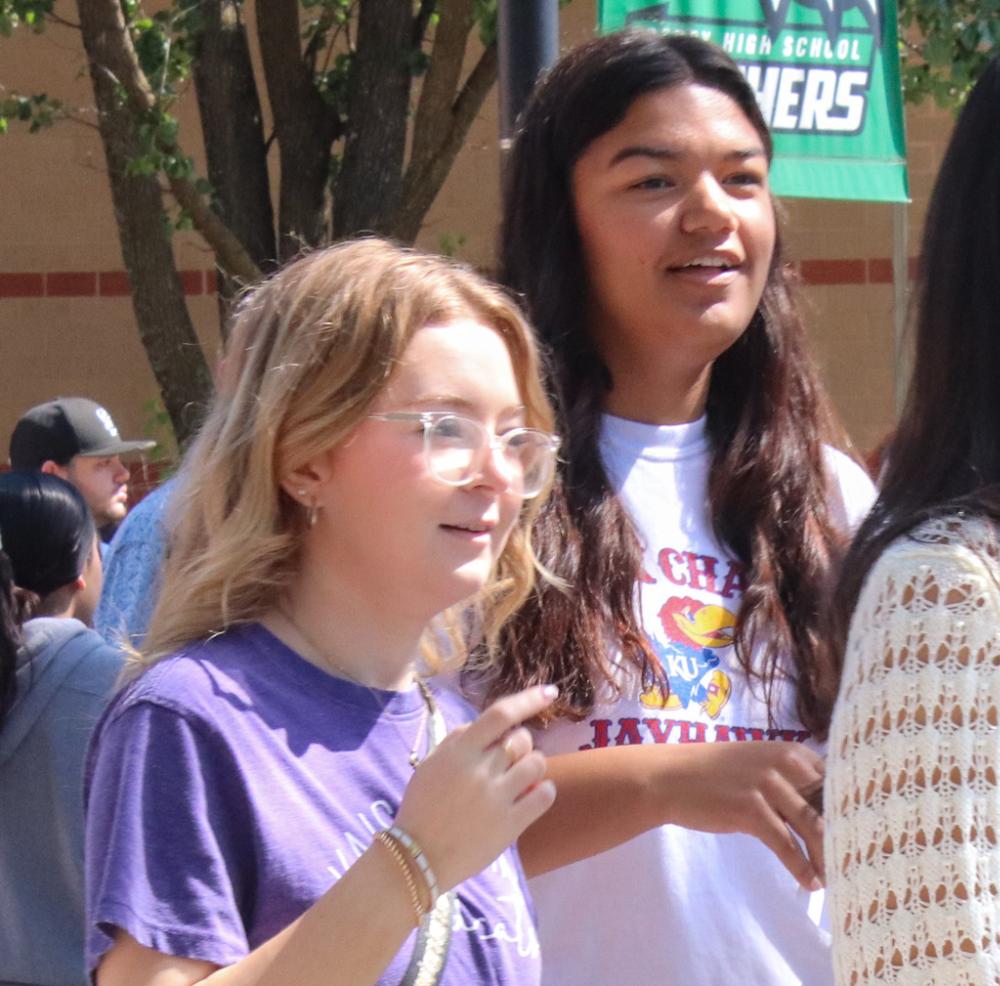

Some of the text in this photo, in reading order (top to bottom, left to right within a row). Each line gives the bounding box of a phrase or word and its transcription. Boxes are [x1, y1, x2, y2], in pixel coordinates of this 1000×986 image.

[722, 32, 771, 55] HIGH
[738, 66, 868, 131] HERS
[658, 547, 746, 599] CHA
[665, 655, 699, 681] KU
